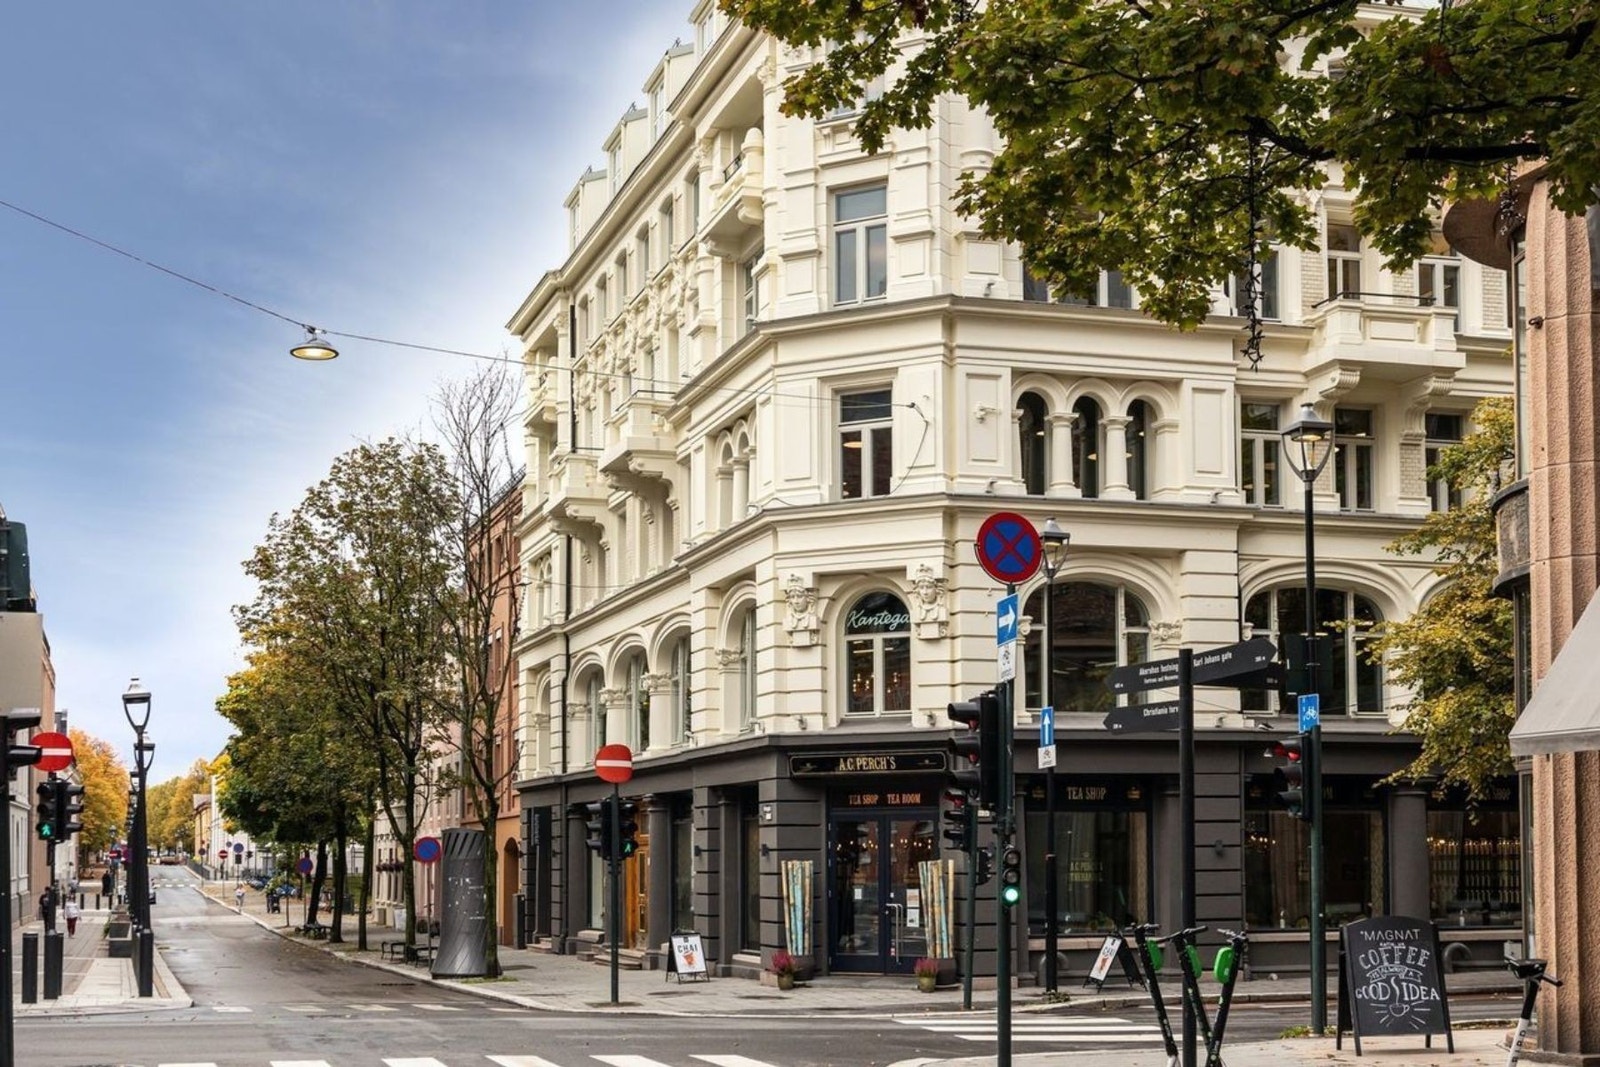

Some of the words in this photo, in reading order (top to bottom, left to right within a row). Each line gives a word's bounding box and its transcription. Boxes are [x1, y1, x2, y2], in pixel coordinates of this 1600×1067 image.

[847, 609, 910, 631] Kantega
[1143, 705, 1168, 716] Christiania
[848, 794, 861, 805] TEA
[862, 794, 879, 805] SHOP
[887, 793, 900, 804] TEA
[901, 792, 920, 804] ROOM
[1066, 786, 1084, 800] TEA
[1085, 786, 1106, 800] SHOP
[677, 944, 698, 954] CHAI
[1359, 946, 1431, 970] COFFEE
[1355, 982, 1391, 1000] GOOD
[1401, 982, 1441, 1001] IDEA
